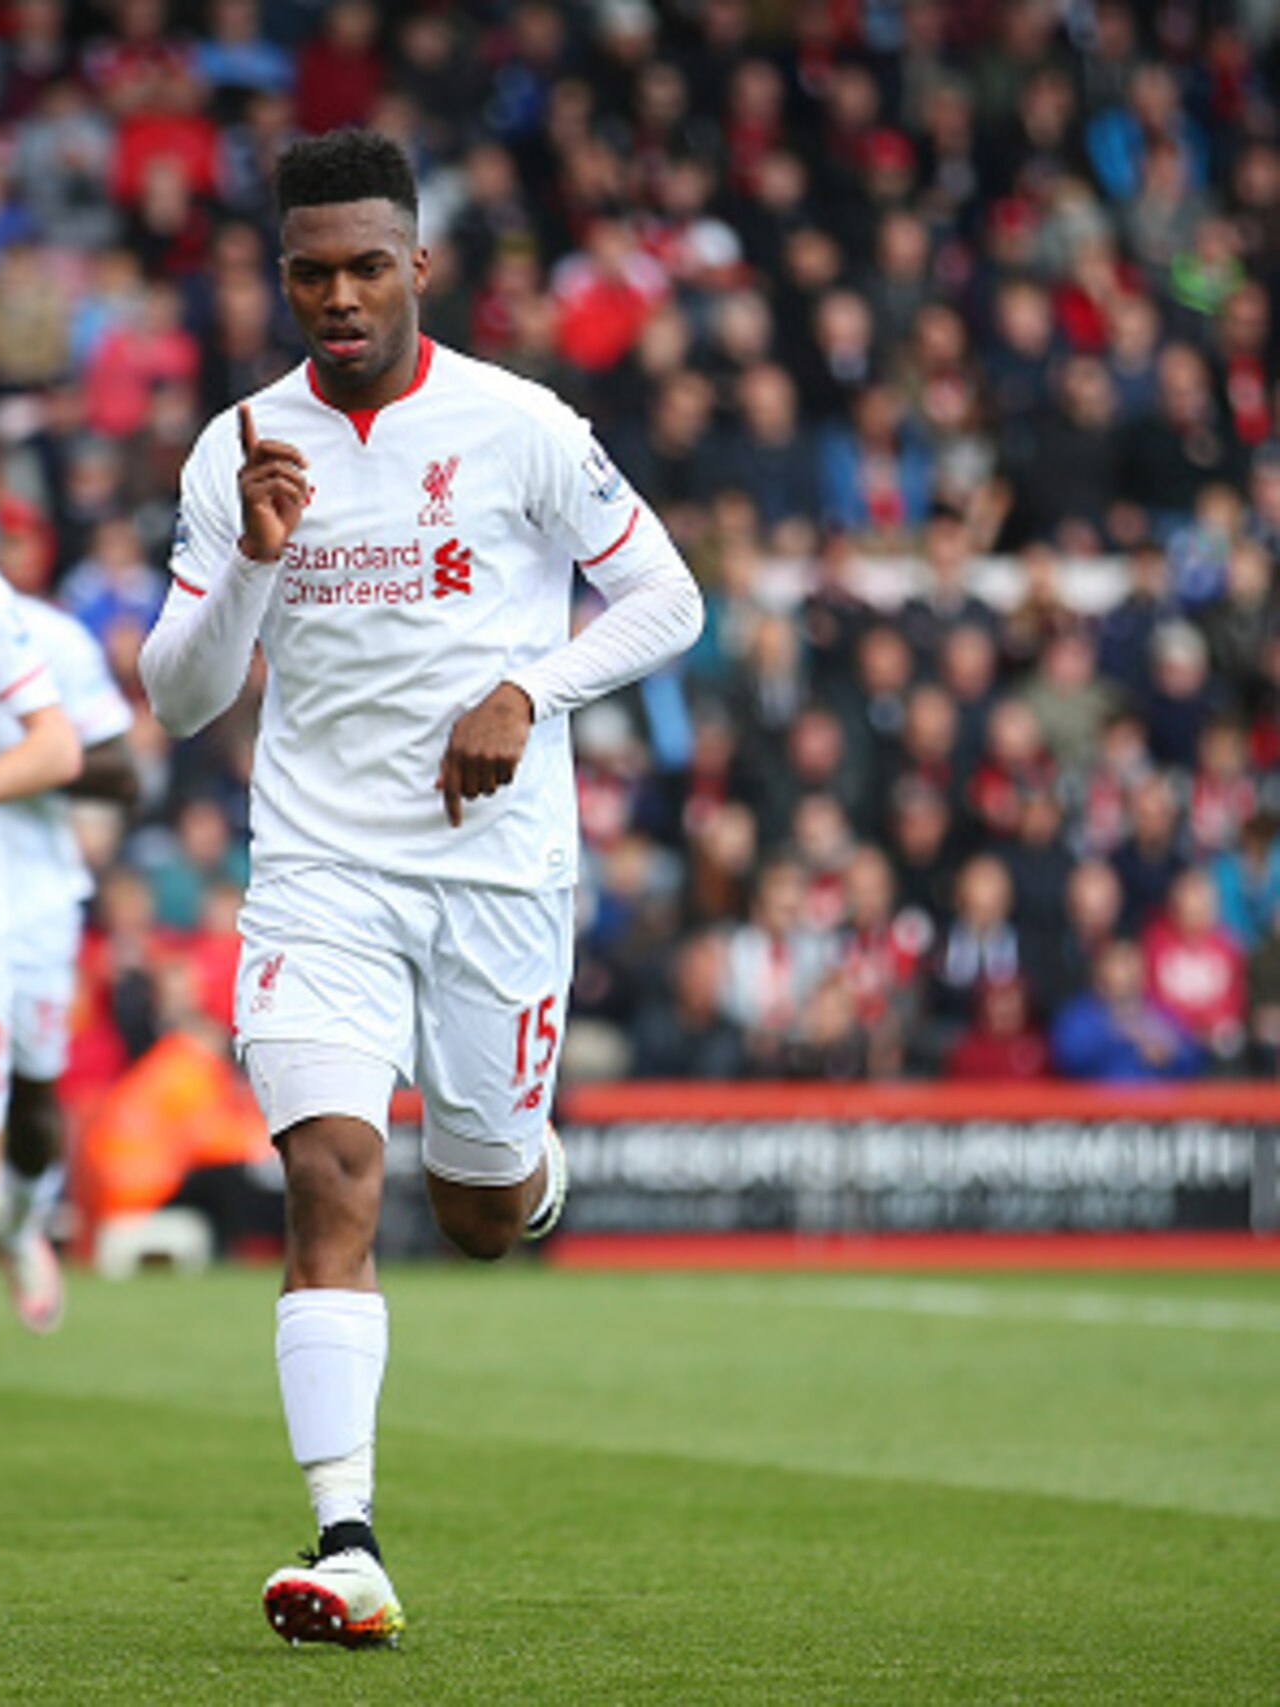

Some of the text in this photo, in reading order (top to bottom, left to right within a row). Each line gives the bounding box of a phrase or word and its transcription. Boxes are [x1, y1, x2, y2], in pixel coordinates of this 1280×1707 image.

[284, 539, 421, 571] Standard
[284, 575, 423, 605] Chartered
[509, 995, 556, 1088] 15
